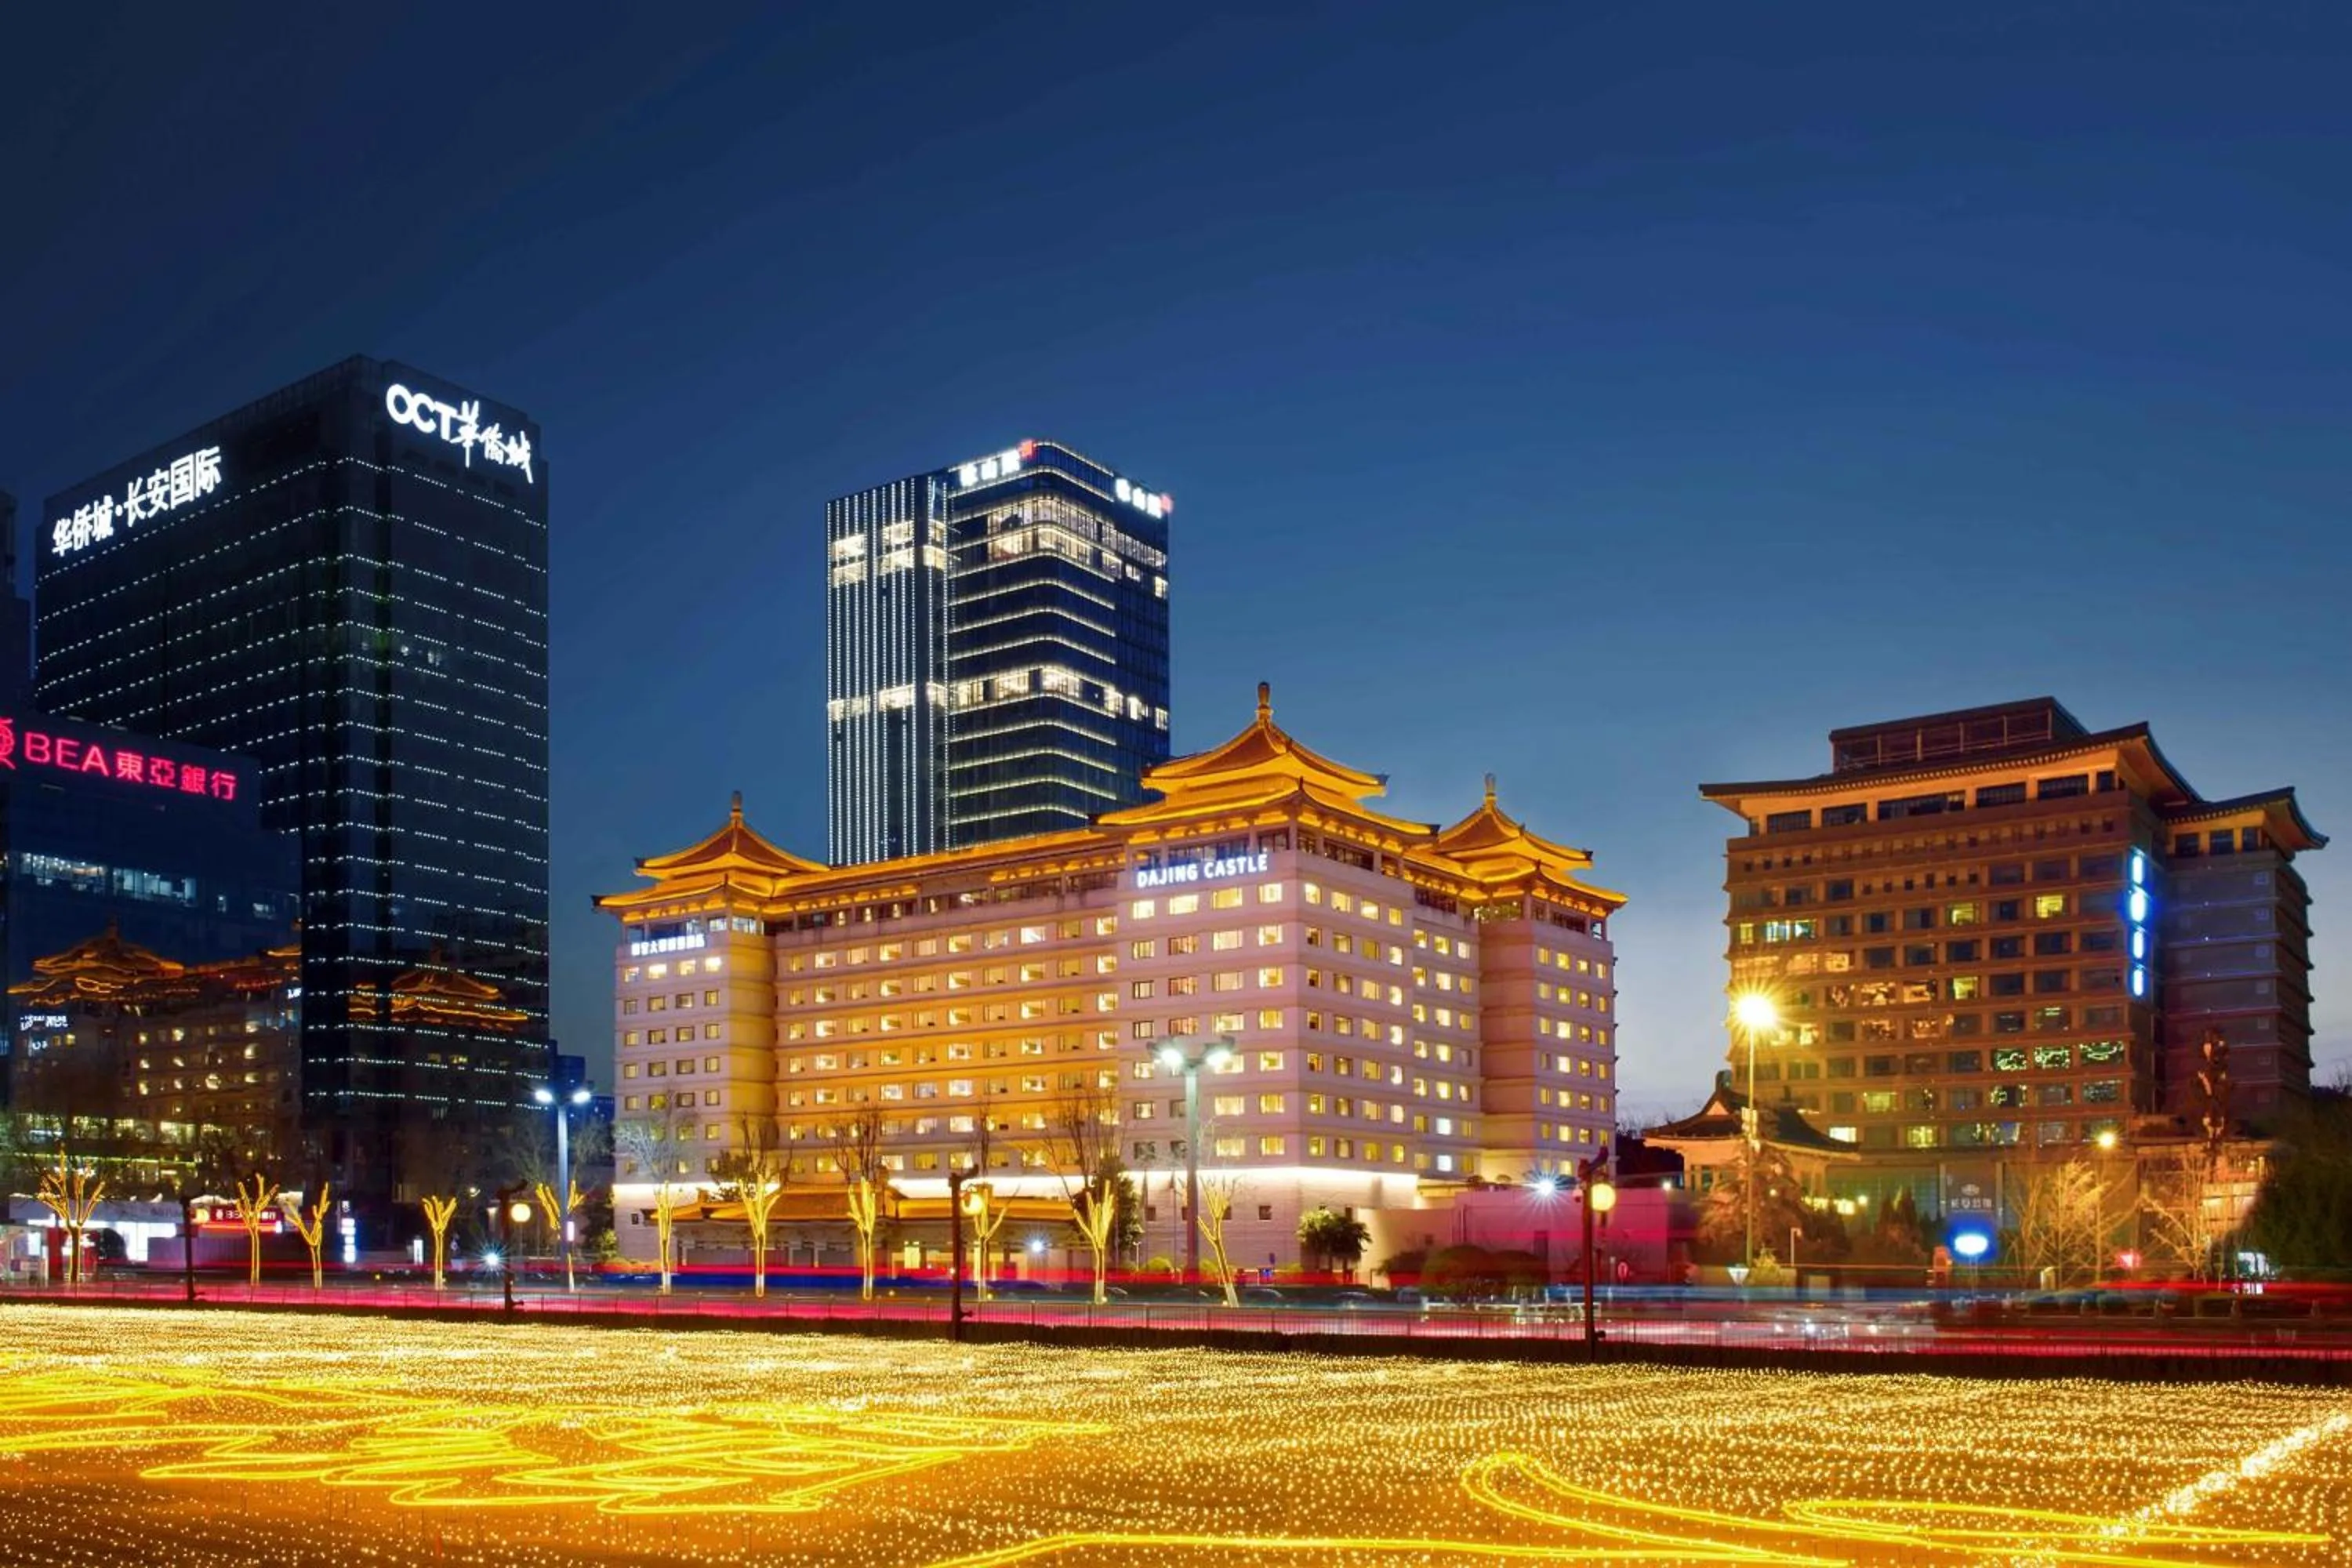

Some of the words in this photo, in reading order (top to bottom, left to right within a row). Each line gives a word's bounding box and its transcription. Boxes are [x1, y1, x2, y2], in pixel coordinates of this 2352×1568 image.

[386, 383, 458, 442] OCT
[24, 731, 109, 776] BEA
[114, 751, 237, 800] 東亞銀行
[1138, 864, 1198, 888] DAJING
[1204, 854, 1268, 879] CASTLE
